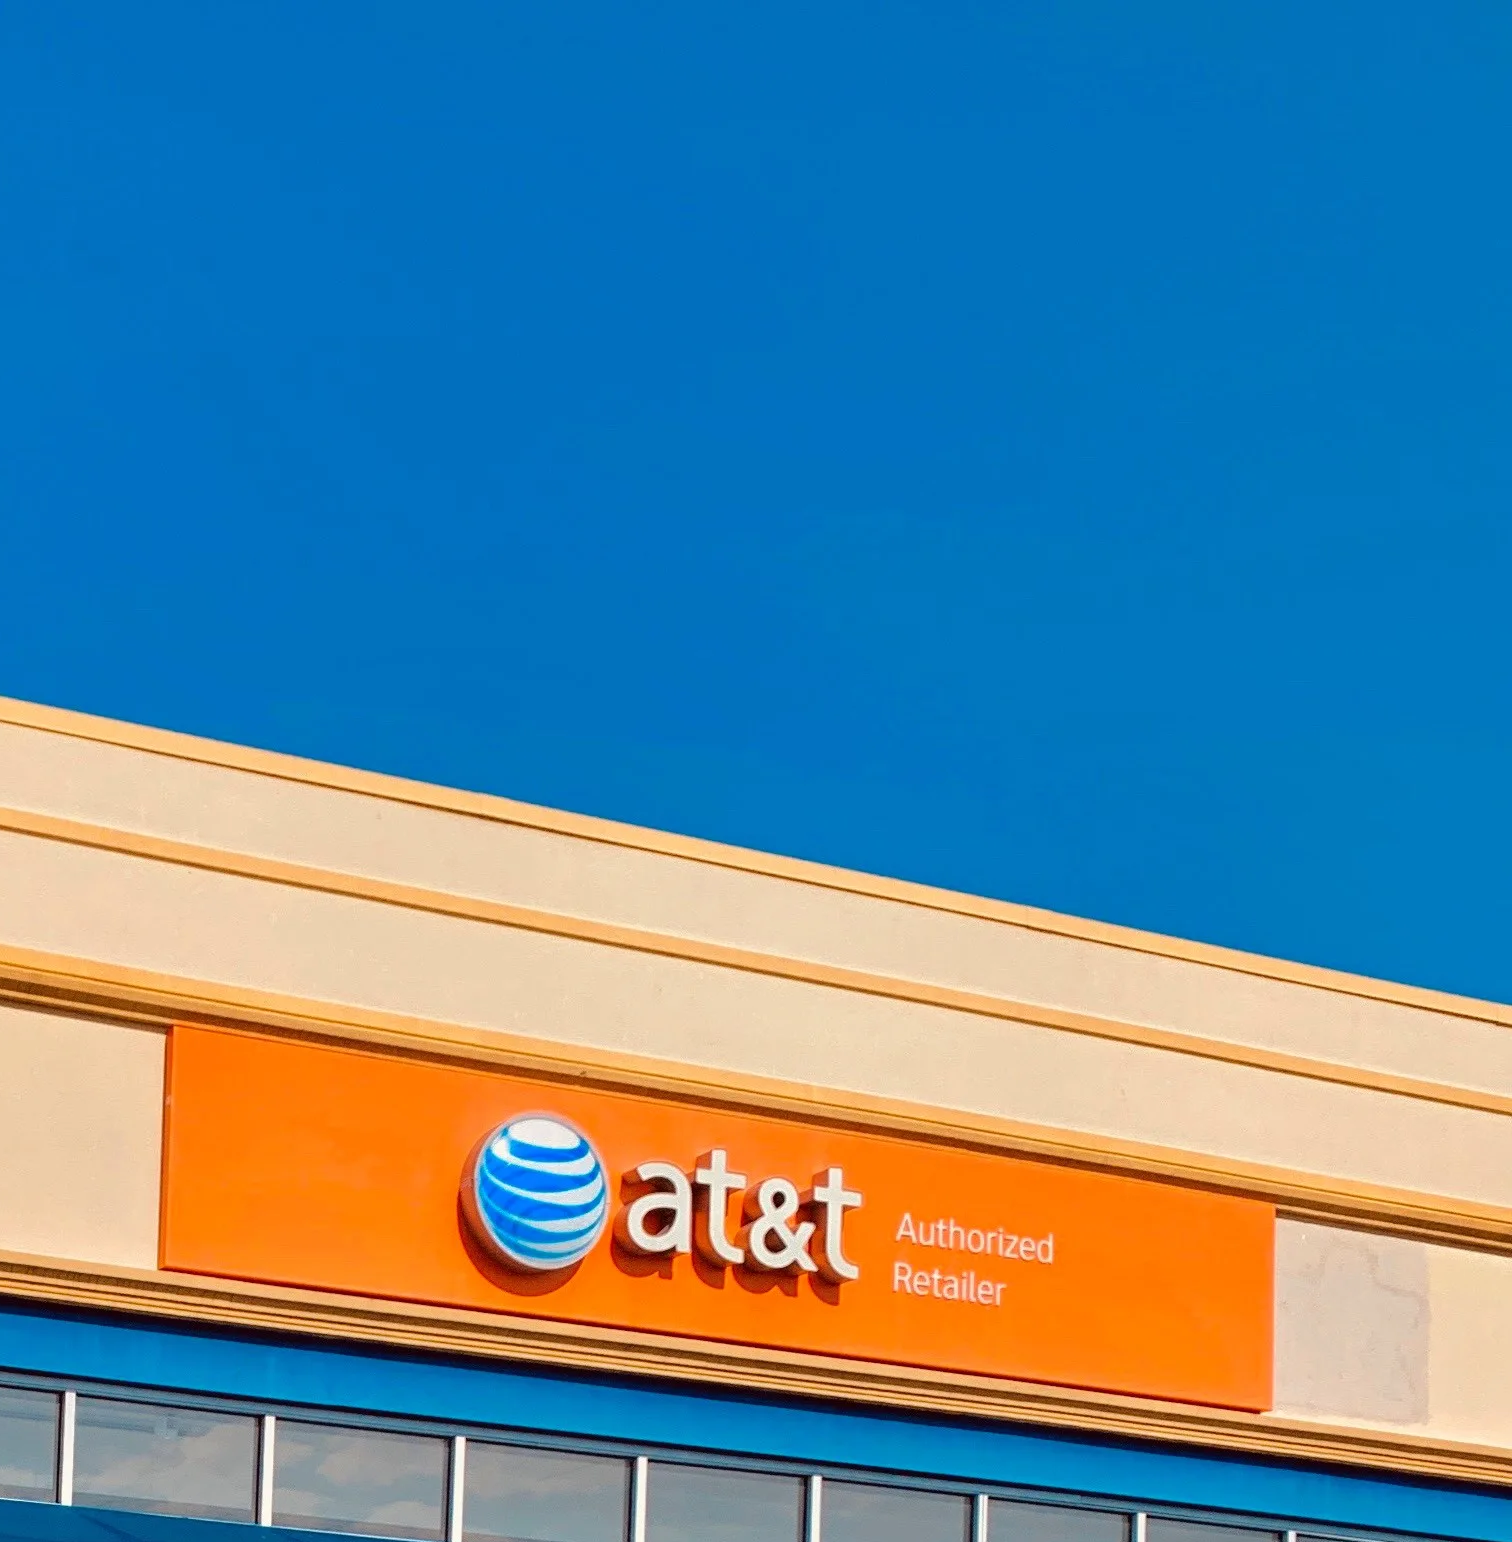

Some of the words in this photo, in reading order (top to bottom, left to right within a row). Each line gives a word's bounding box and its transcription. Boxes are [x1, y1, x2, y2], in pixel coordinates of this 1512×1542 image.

[626, 1148, 863, 1280] at&t
[896, 1211, 1054, 1264] Authorized
[892, 1262, 1006, 1305] Retailer
